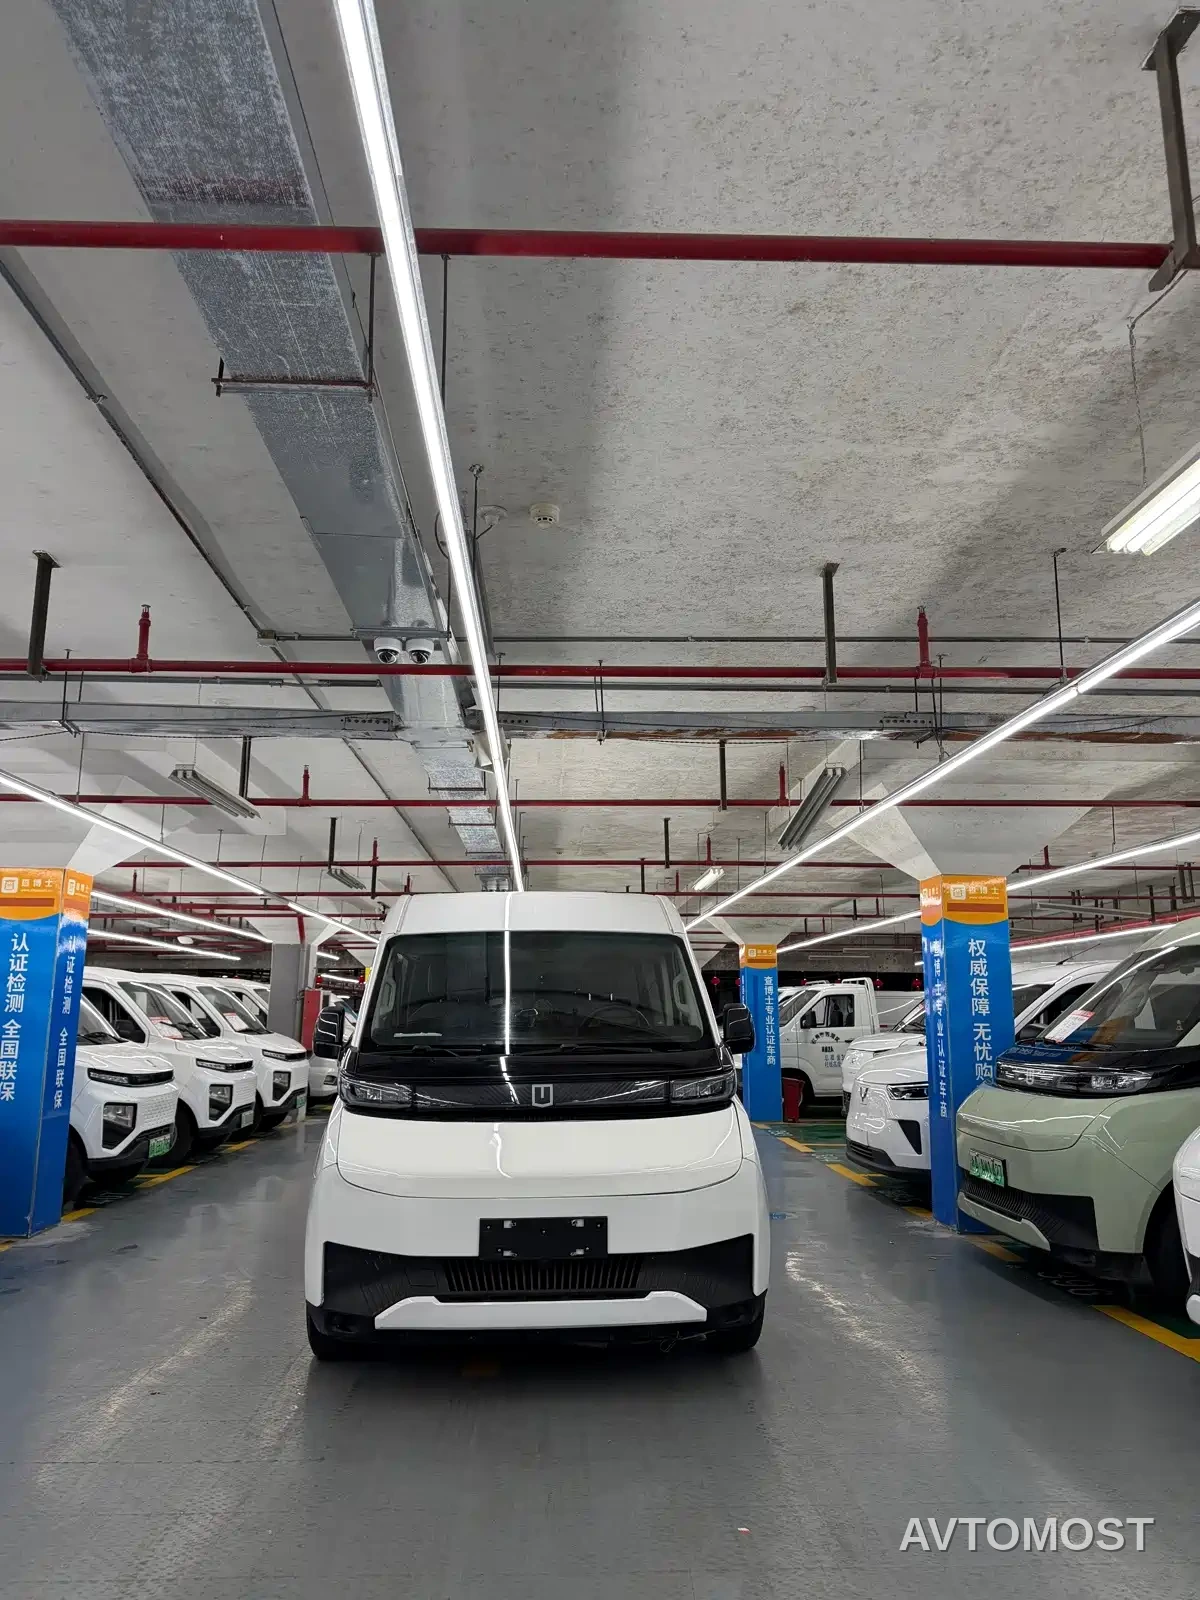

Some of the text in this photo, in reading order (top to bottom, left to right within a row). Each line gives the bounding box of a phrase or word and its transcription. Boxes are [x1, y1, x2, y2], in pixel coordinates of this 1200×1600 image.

[0, 933, 30, 1102] 认证检测 全国联保
[53, 935, 77, 1110] 认证检测 全国联保
[764, 975, 776, 1066] 查博士专业认证车商
[968, 938, 991, 1017] 权威保障
